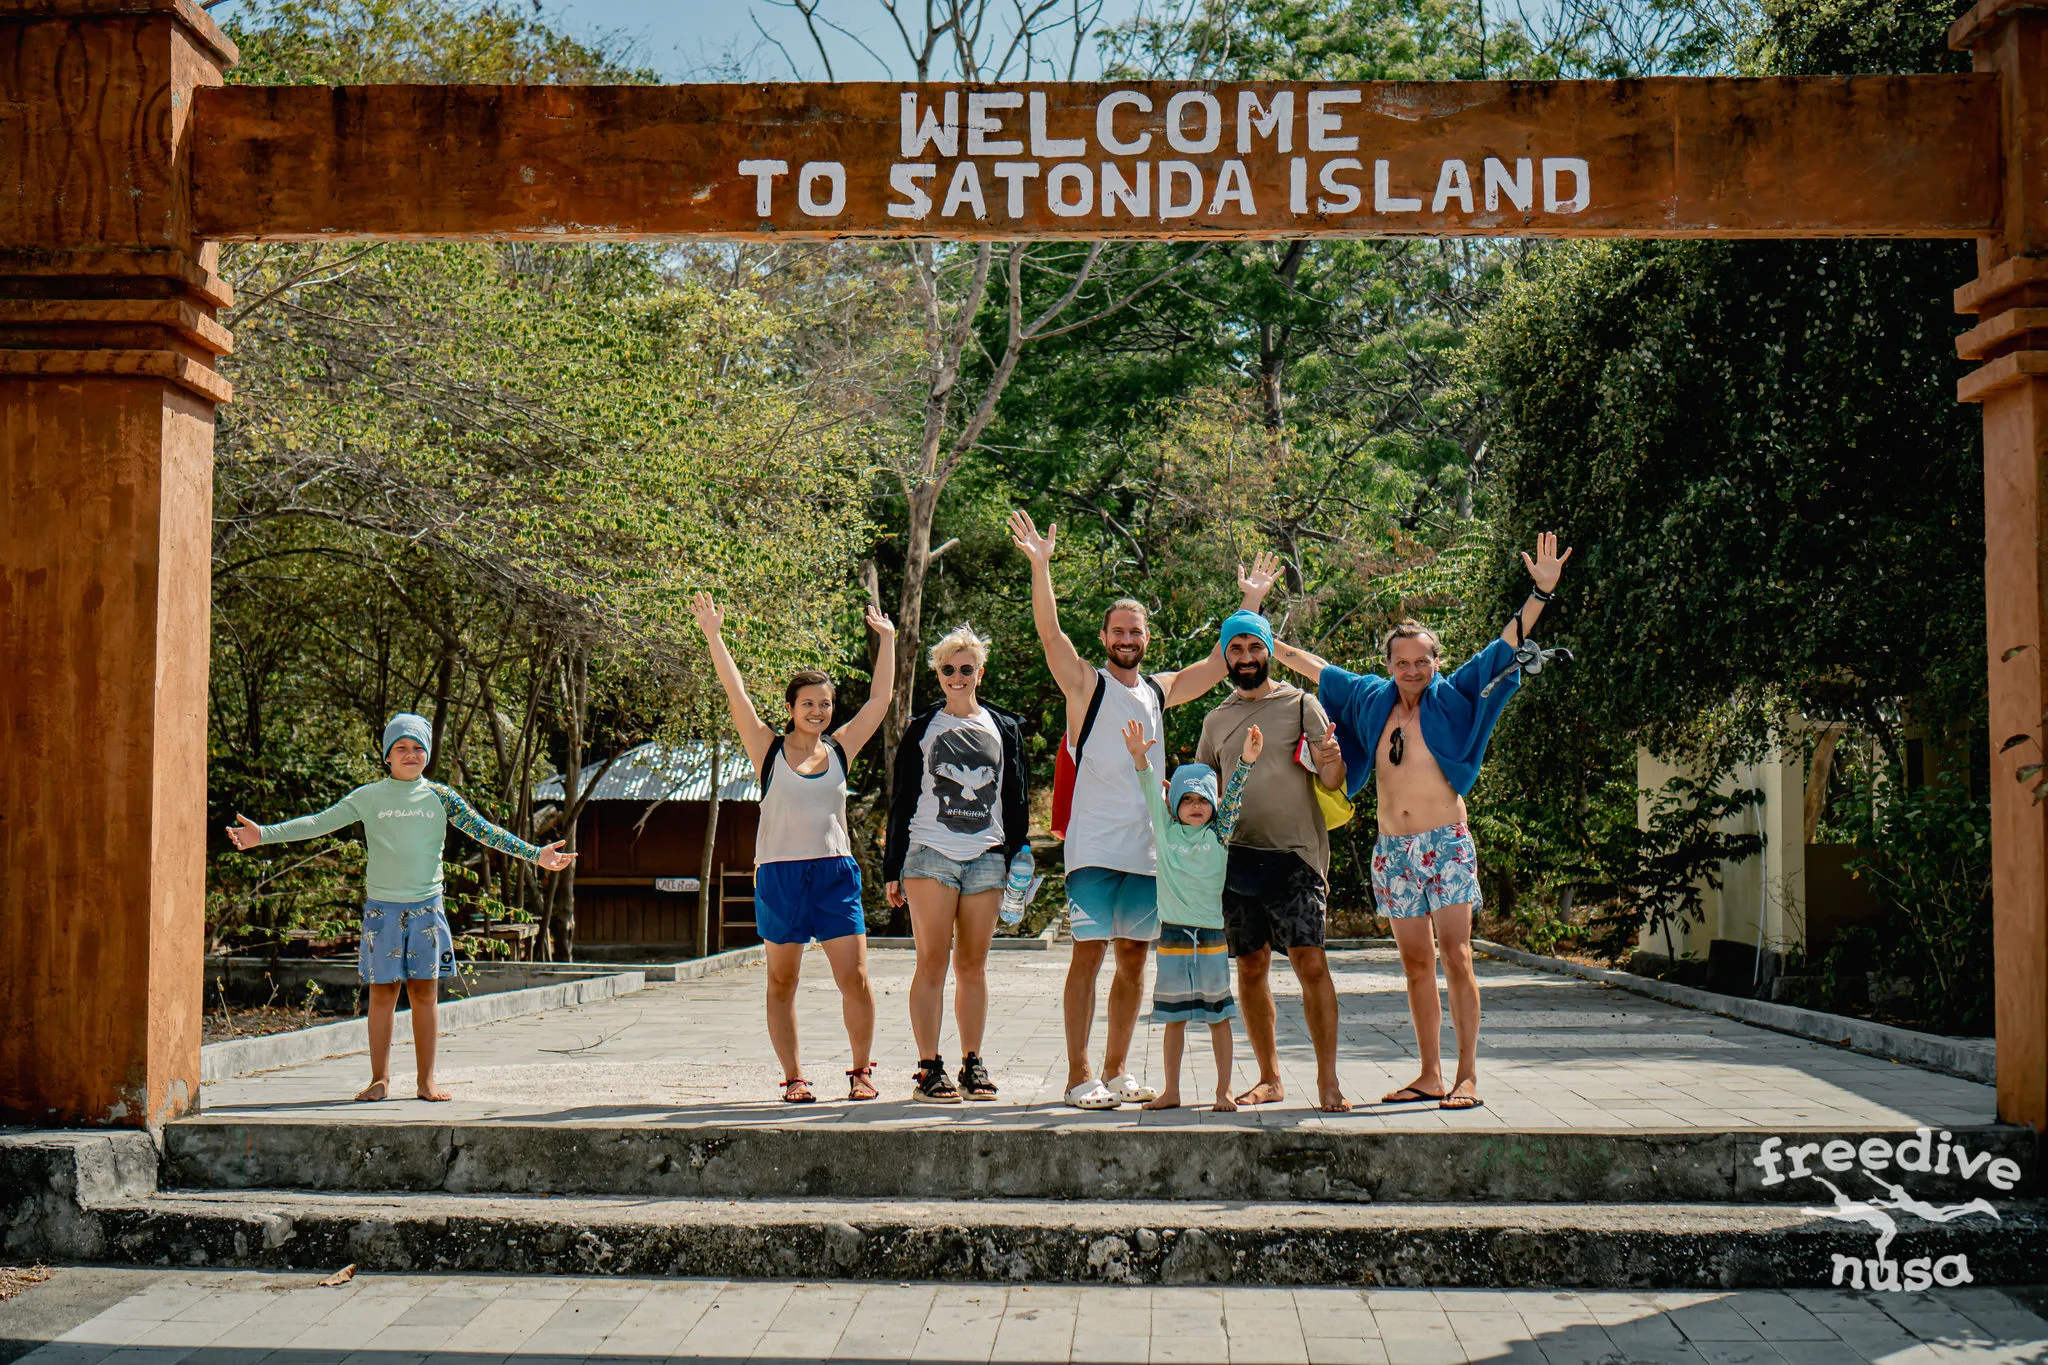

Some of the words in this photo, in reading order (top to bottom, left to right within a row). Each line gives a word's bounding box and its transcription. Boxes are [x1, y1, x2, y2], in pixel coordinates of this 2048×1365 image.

[901, 90, 1361, 157] WELCOME
[738, 160, 846, 217] TO
[888, 160, 1256, 220] SATONDA
[1290, 158, 1590, 214] ISLAND
[947, 808, 986, 818] RELIGION
